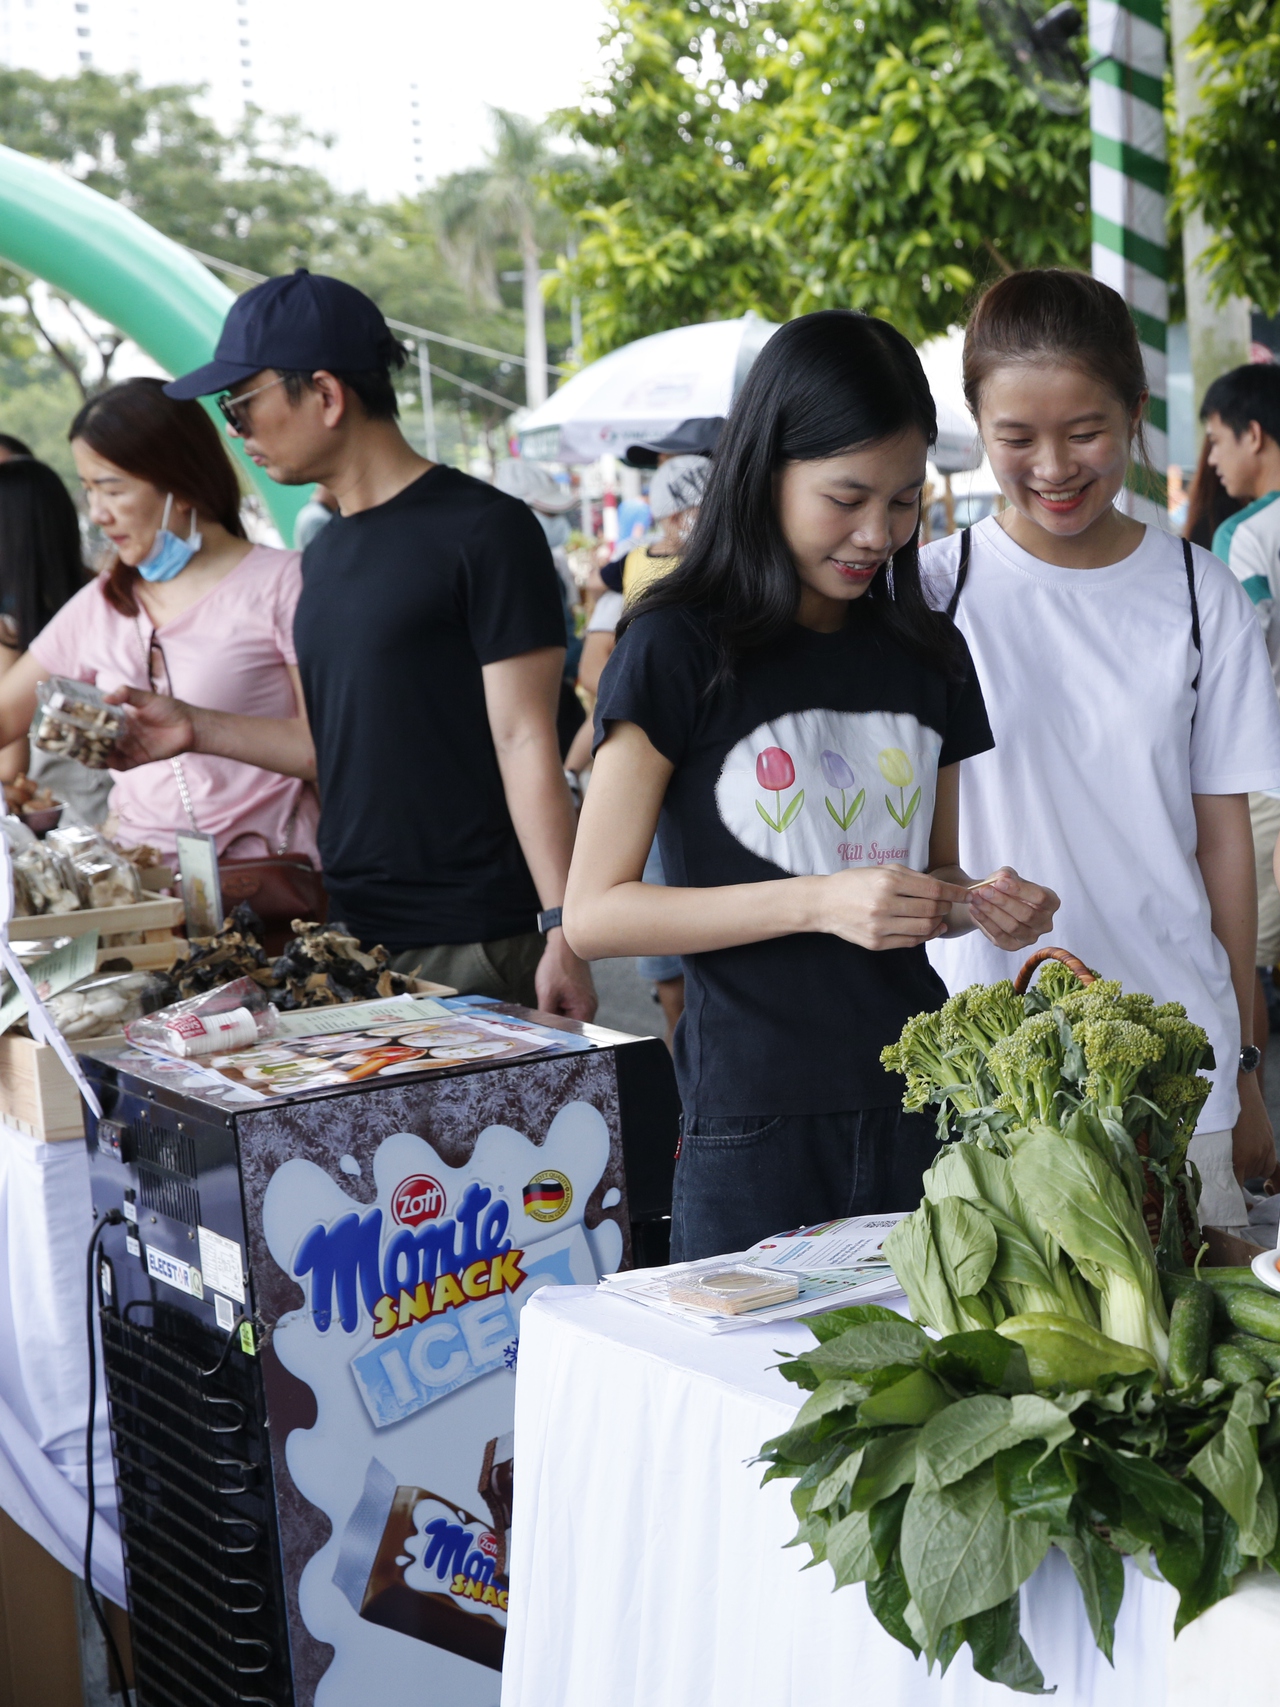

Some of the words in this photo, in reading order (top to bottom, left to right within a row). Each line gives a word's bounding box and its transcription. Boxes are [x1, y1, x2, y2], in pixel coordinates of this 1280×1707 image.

[836, 842, 864, 861] Kill
[399, 1187, 443, 1220] Zott
[293, 1182, 512, 1334] Monte
[373, 1249, 528, 1339] SNACK
[449, 1572, 510, 1613] SNAC
